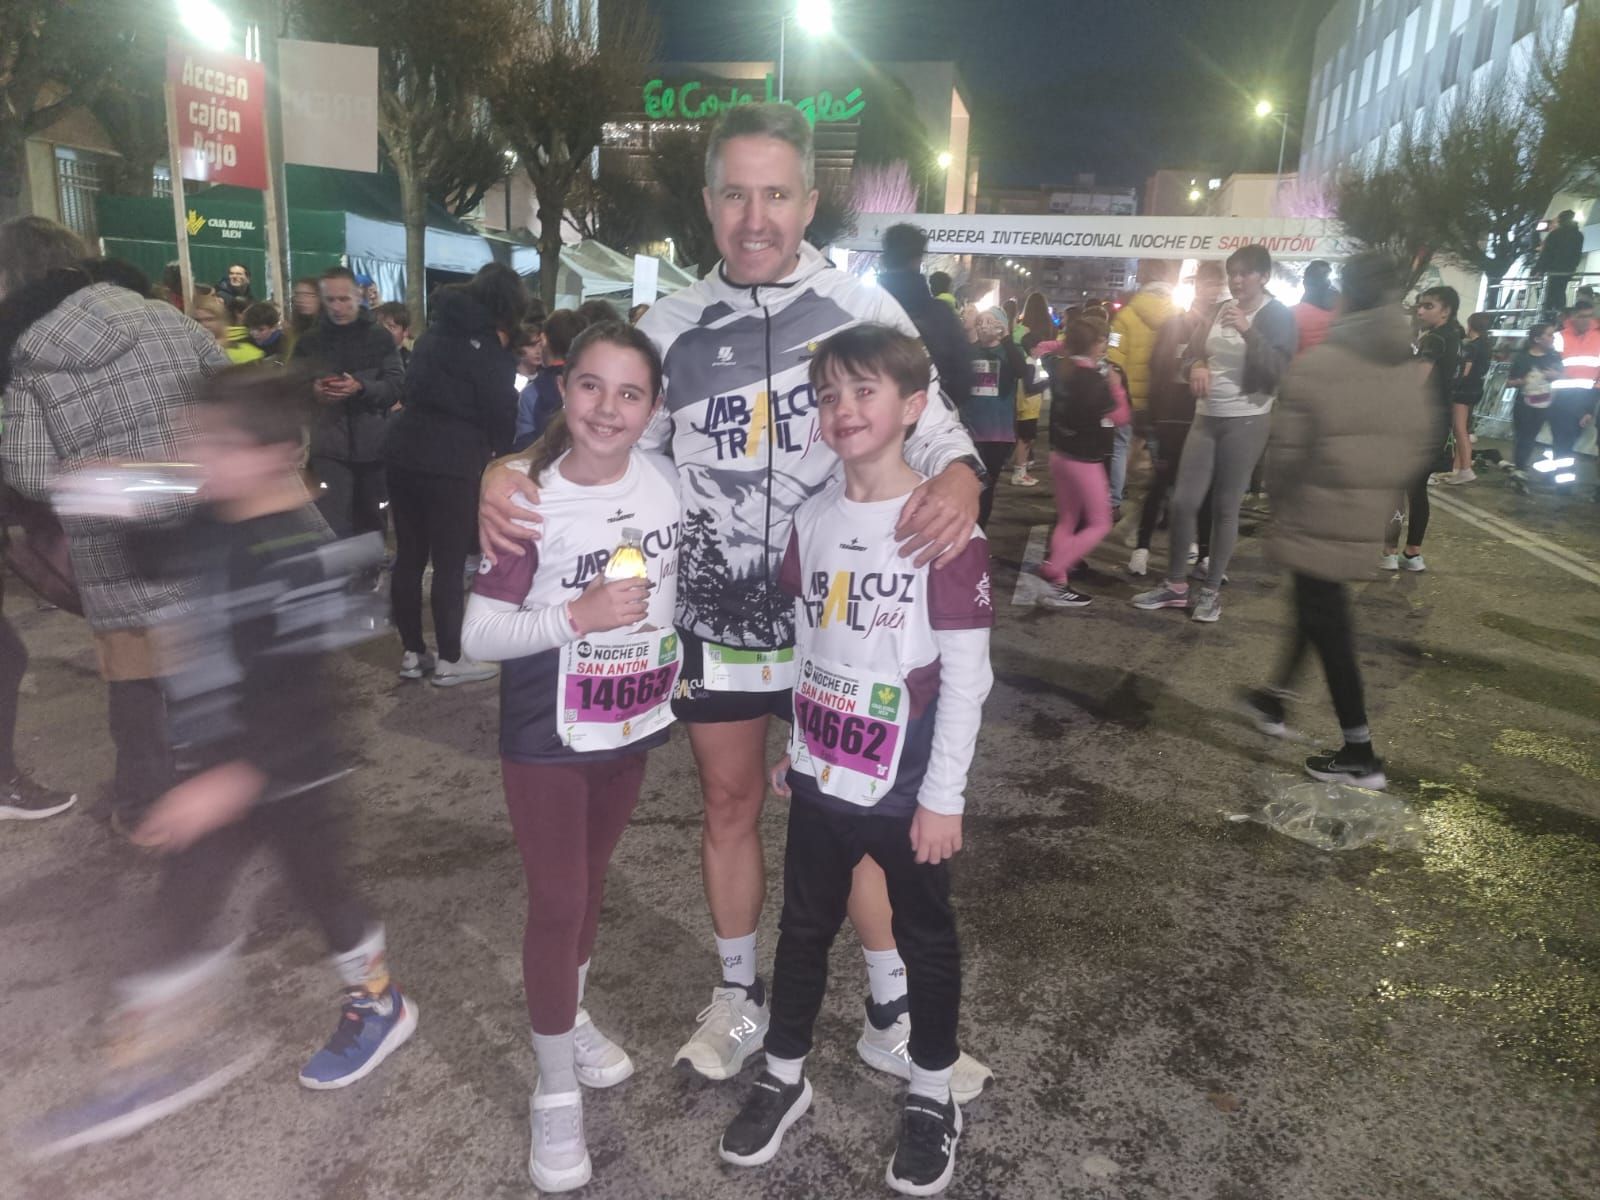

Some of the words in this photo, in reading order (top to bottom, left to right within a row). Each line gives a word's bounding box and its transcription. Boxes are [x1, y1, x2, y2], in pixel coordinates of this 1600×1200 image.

[182, 56, 248, 101] Acceso
[189, 96, 240, 134] cajón
[990, 231, 1123, 247] INTERNACIONAL
[1129, 234, 1187, 249] NOCHE
[1190, 236, 1213, 249] DE
[576, 662, 605, 676] SAN
[607, 658, 649, 675] ANTÓN
[594, 647, 634, 661] NOCHE
[636, 645, 650, 656] DE
[576, 666, 672, 711] 14663
[801, 681, 818, 699] SAN
[818, 691, 856, 713] ANTÓN
[812, 670, 841, 692] NOCHE
[842, 682, 859, 696] DE
[799, 701, 888, 762] 14662
